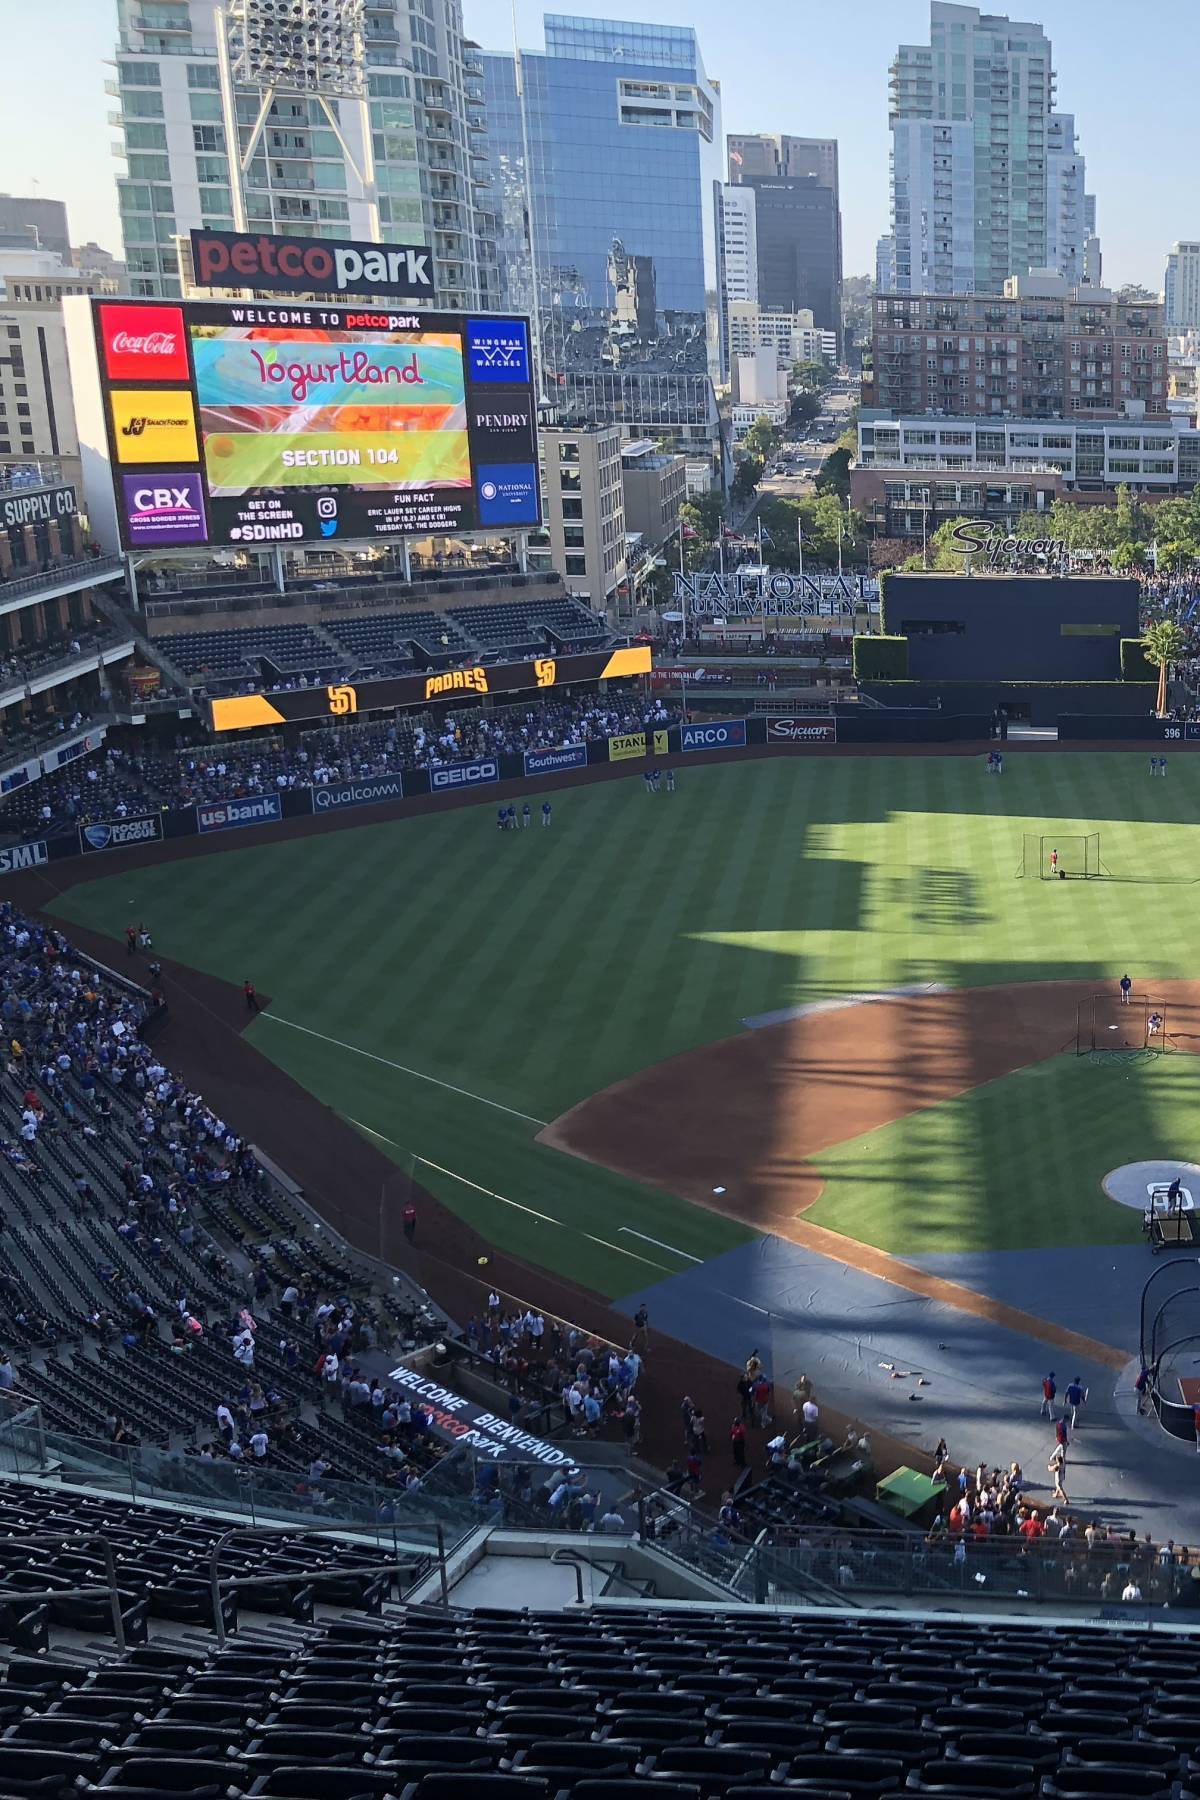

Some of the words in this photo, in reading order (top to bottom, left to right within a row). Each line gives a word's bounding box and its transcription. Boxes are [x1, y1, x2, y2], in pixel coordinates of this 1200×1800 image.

[231, 309, 312, 325] WELCOME
[320, 313, 340, 326] TO
[474, 338, 521, 346] WINGMAN
[476, 359, 521, 367] WATCHES
[250, 349, 424, 403] Yogurtland
[476, 414, 528, 427] PENDRY
[281, 449, 361, 467] SECTION
[367, 448, 399, 465] 104
[498, 483, 532, 491] NATIONAL
[133, 487, 192, 512] CBX
[248, 500, 266, 510] GET
[268, 499, 281, 509] ON
[394, 494, 411, 503] FUN
[413, 493, 435, 502] FACT
[4, 493, 52, 526] SUPPLY
[55, 490, 77, 515] CO.
[237, 511, 257, 521] THE
[257, 510, 294, 520] SCREEN
[383, 507, 404, 516] LAUER
[418, 506, 442, 514] CAREER
[443, 504, 462, 512] HIGHS
[130, 516, 151, 524] CROSS
[375, 523, 403, 532] TUESDAY
[428, 520, 458, 529] DODGERS
[417, 514, 430, 522] AND
[949, 519, 1068, 563] Sycuan
[671, 570, 876, 601] NATIONAL
[691, 597, 859, 617] UNIVERSITY
[425, 666, 489, 700] PADRES
[683, 728, 728, 745] ARCO
[769, 719, 833, 740] Sycuan
[1164, 728, 1180, 739] 396
[612, 733, 664, 751] STANLY
[528, 752, 577, 769] Southwest
[432, 763, 497, 787] GEICO
[316, 782, 400, 808] Qualcomm
[111, 819, 156, 835] ROCKET
[112, 827, 157, 843] LEAGUE
[387, 1366, 469, 1413] WELCOME
